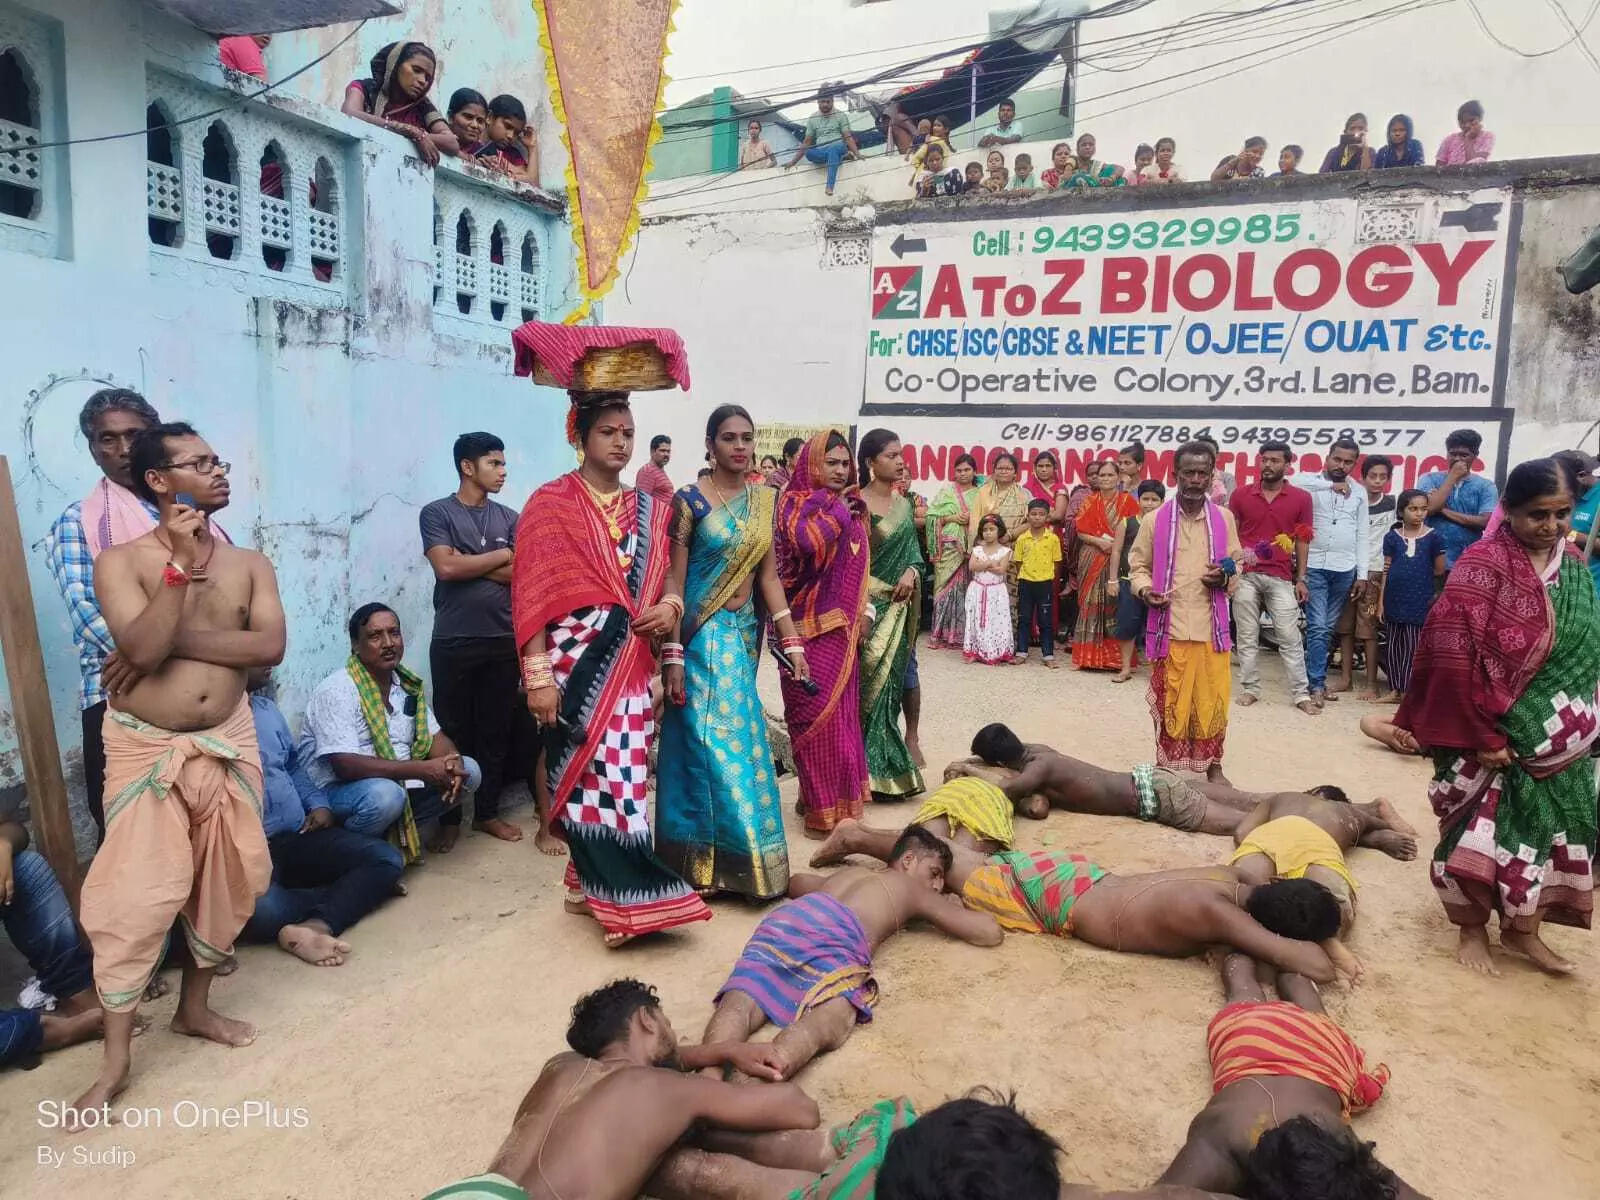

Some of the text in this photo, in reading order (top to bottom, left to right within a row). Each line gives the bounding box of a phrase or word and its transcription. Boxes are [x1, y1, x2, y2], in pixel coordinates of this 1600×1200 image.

[874, 271, 918, 311] A Z
[1099, 239, 1496, 315] BIOLOGY
[885, 367, 1097, 403] Co-Operative
